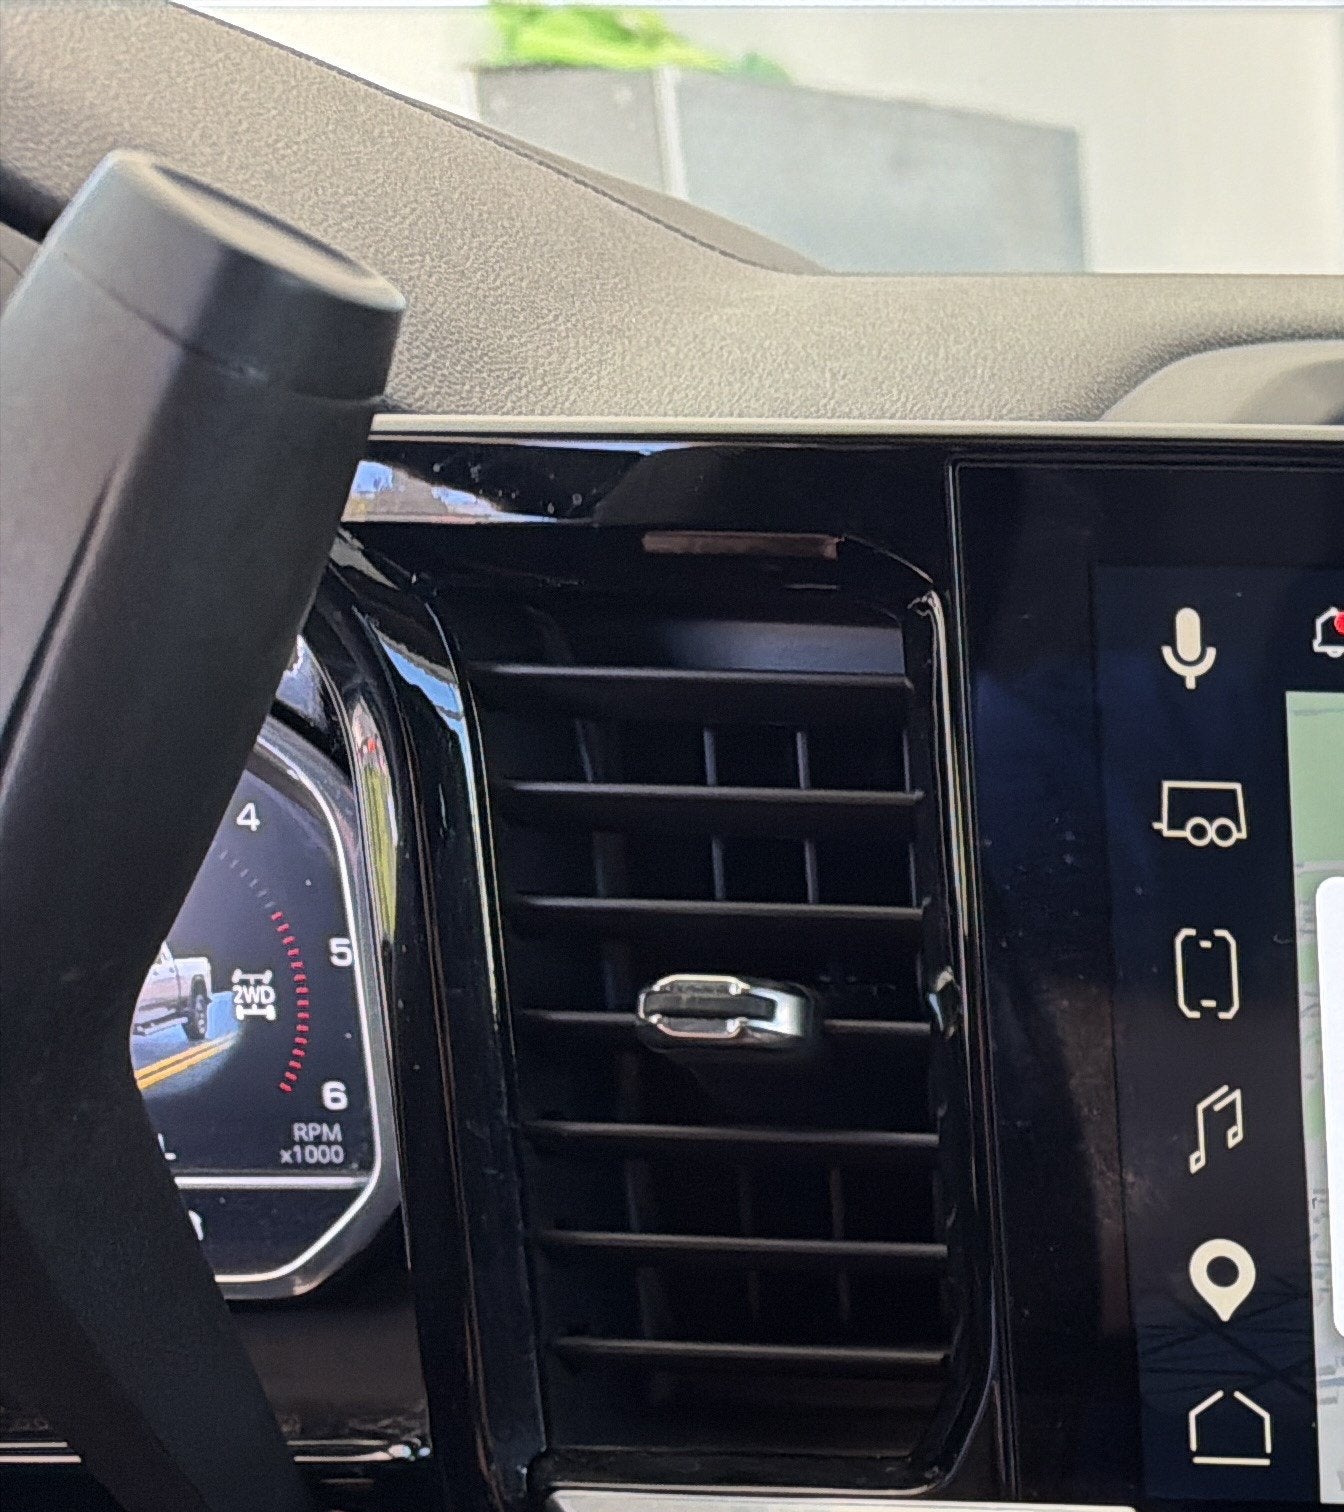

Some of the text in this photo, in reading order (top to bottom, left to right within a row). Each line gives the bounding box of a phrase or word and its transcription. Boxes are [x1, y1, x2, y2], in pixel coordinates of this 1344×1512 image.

[236, 804, 261, 831] 4
[329, 938, 352, 967] 5
[233, 985, 275, 1005] 2WD
[321, 1080, 349, 1111] 6
[293, 1122, 342, 1143] RPM
[280, 1144, 344, 1164] x1000
